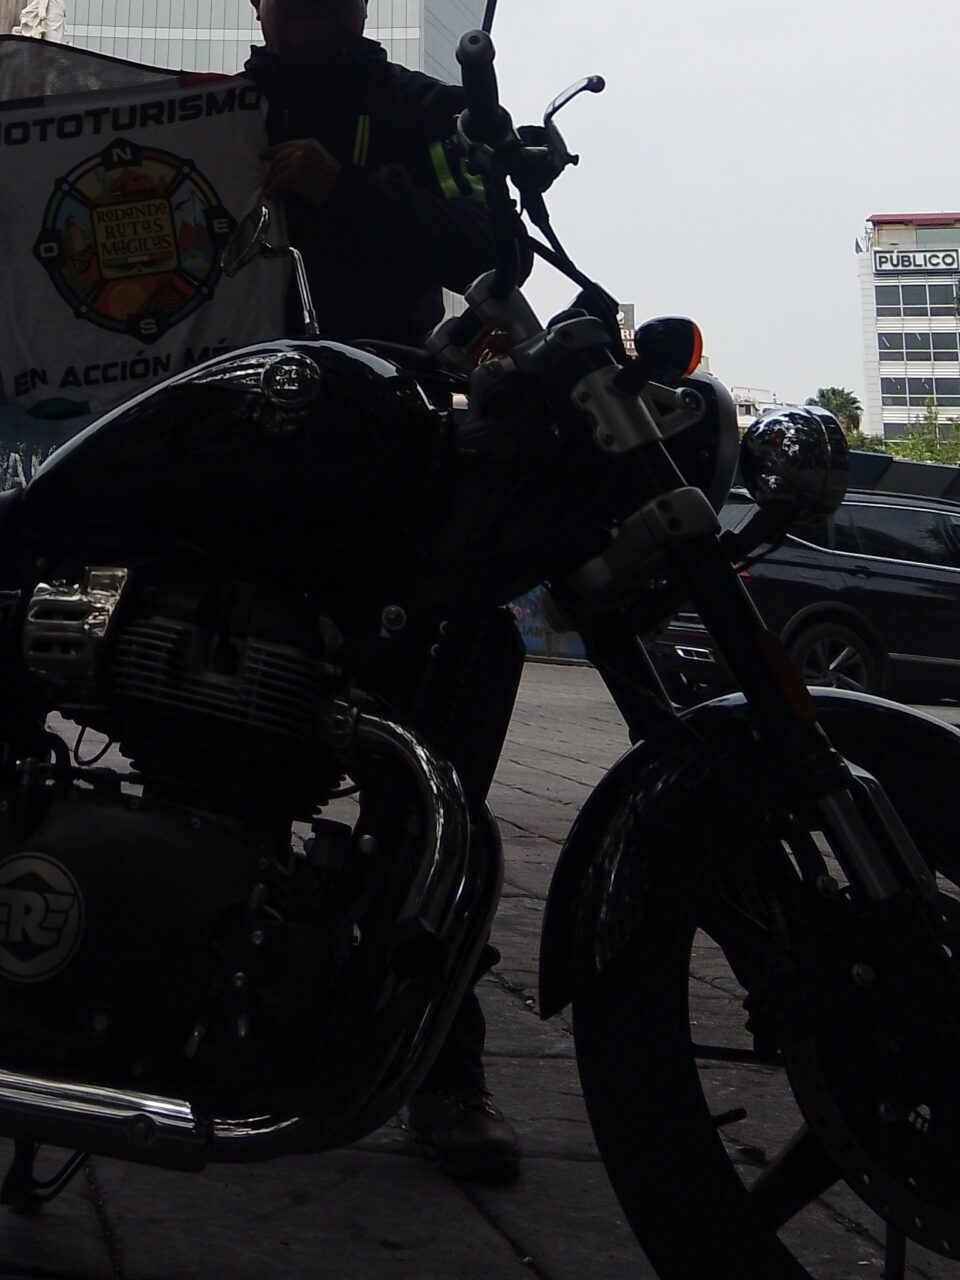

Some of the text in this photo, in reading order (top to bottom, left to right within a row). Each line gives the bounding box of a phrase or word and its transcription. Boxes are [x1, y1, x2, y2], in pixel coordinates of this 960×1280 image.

[113, 147, 132, 162] N
[214, 220, 229, 234] E
[140, 321, 158, 334] S
[15, 368, 47, 397] EN
[60, 352, 171, 388] ACCIÓN
